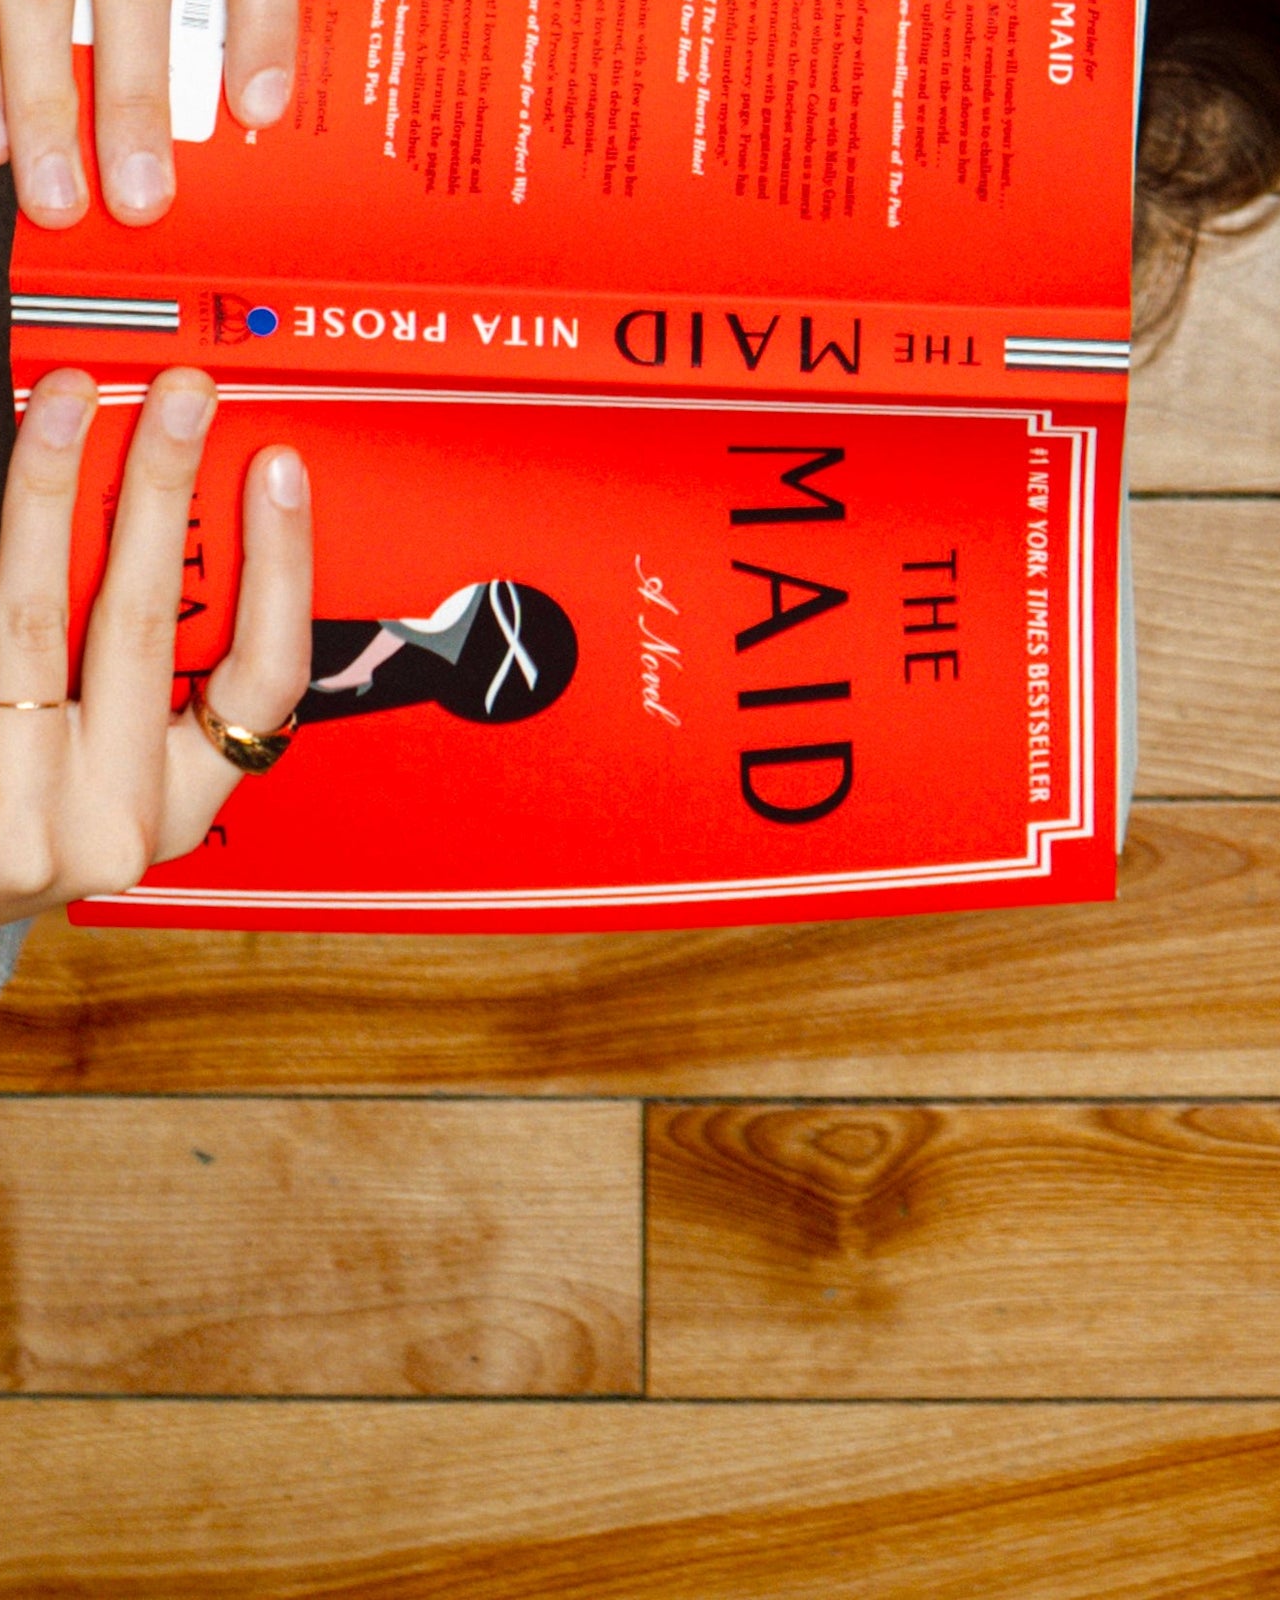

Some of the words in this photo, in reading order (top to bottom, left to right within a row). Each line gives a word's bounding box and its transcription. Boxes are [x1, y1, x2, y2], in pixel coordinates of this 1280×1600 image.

[526, 15, 540, 30] of
[520, 34, 539, 83] Recipe
[1047, 3, 1076, 85] MAID
[1082, 58, 1098, 81] for
[520, 85, 537, 107] for
[520, 110, 530, 119] a
[890, 102, 905, 147] author
[513, 123, 532, 173] Perfect
[889, 150, 903, 165] of
[511, 177, 528, 205] Wife
[888, 170, 904, 193] The
[886, 198, 902, 227] Push
[292, 305, 449, 345] PROSE
[476, 314, 581, 349] NITA
[614, 308, 863, 376] MAID
[893, 333, 984, 367] THE
[1028, 447, 1050, 465] #1
[1027, 471, 1050, 512] NEW
[1027, 518, 1049, 578] YORK
[634, 554, 680, 616] A
[727, 445, 854, 826] MAID
[901, 548, 959, 684] THE
[1027, 587, 1049, 657] TIMES
[638, 614, 683, 728] Novel
[1027, 663, 1051, 805] BESTSELLER
